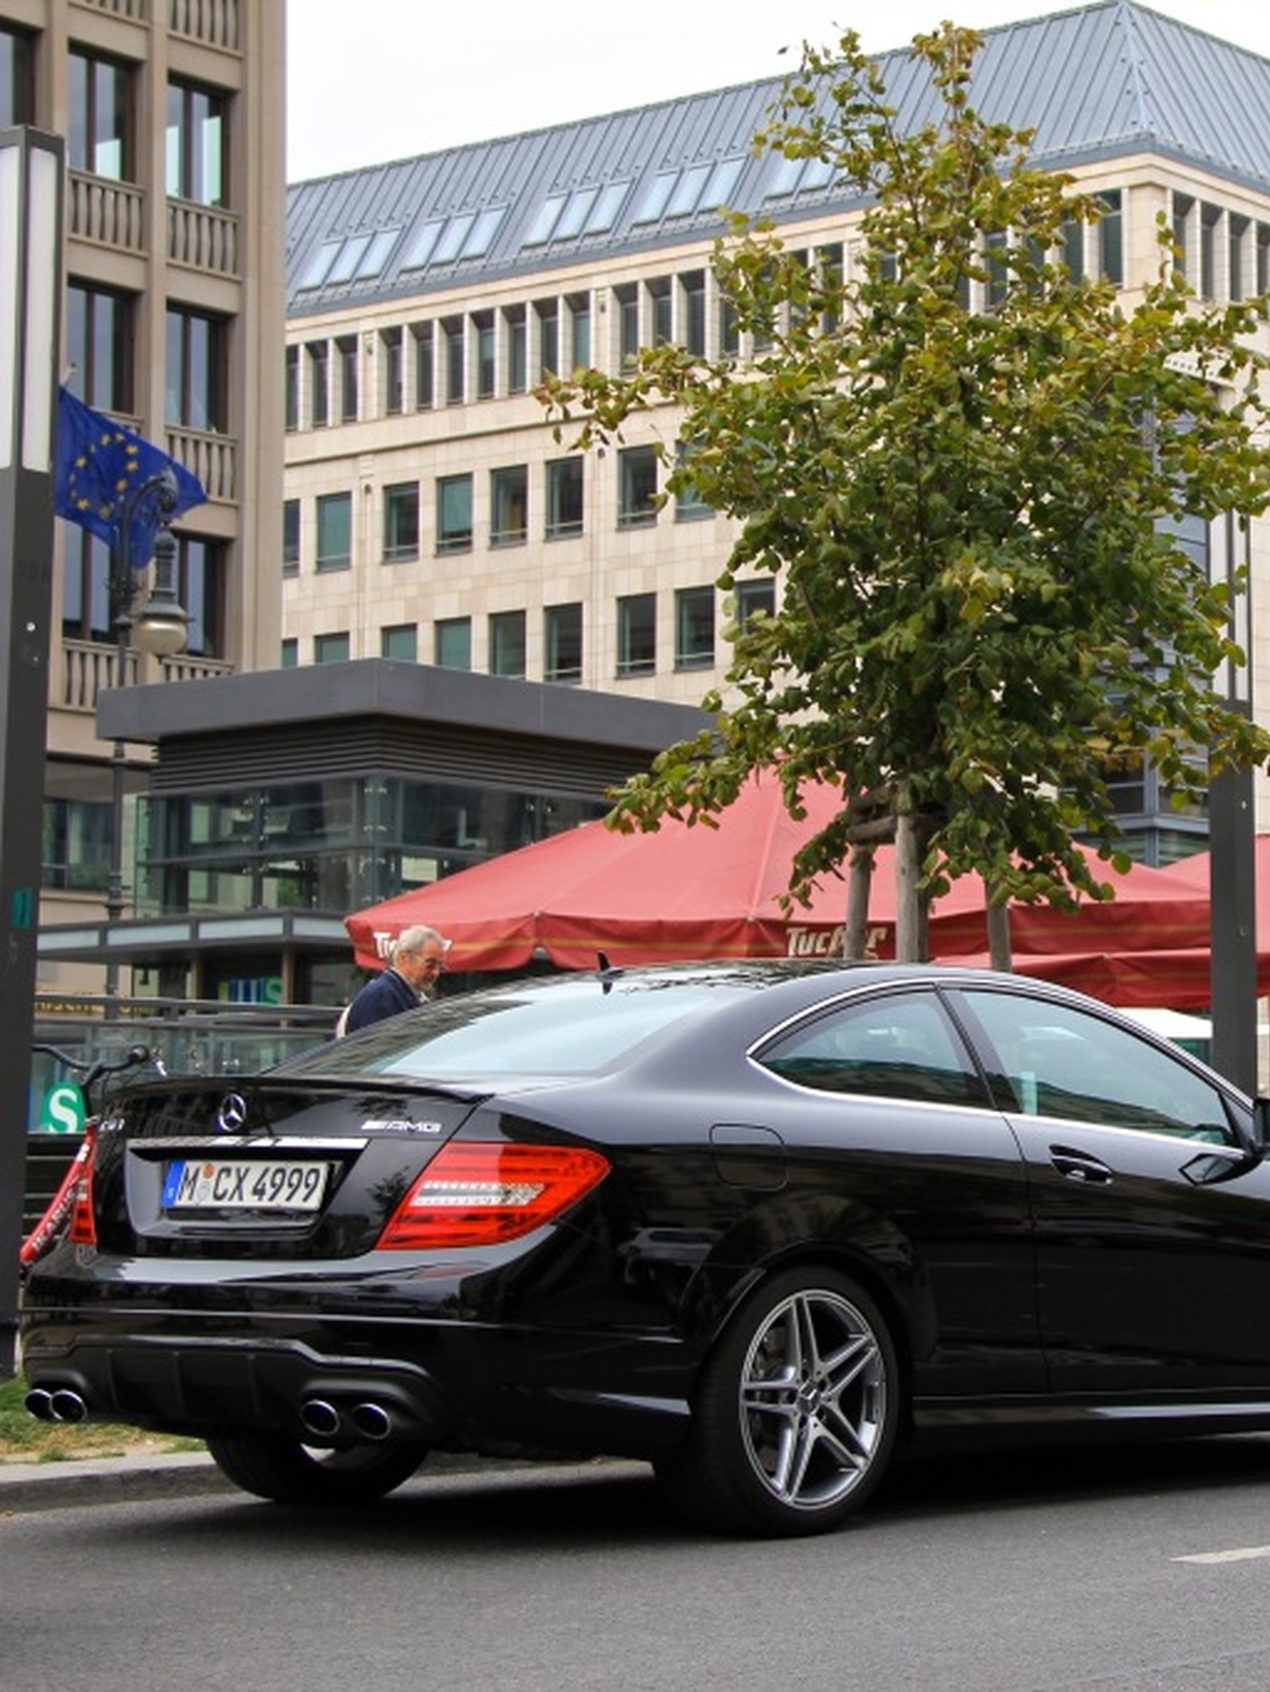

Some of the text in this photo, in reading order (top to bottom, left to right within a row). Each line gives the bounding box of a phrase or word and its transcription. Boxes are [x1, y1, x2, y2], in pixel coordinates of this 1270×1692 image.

[48, 1087, 78, 1133] S
[384, 1121, 442, 1133] AMG
[178, 1165, 321, 1203] M CX 4999
